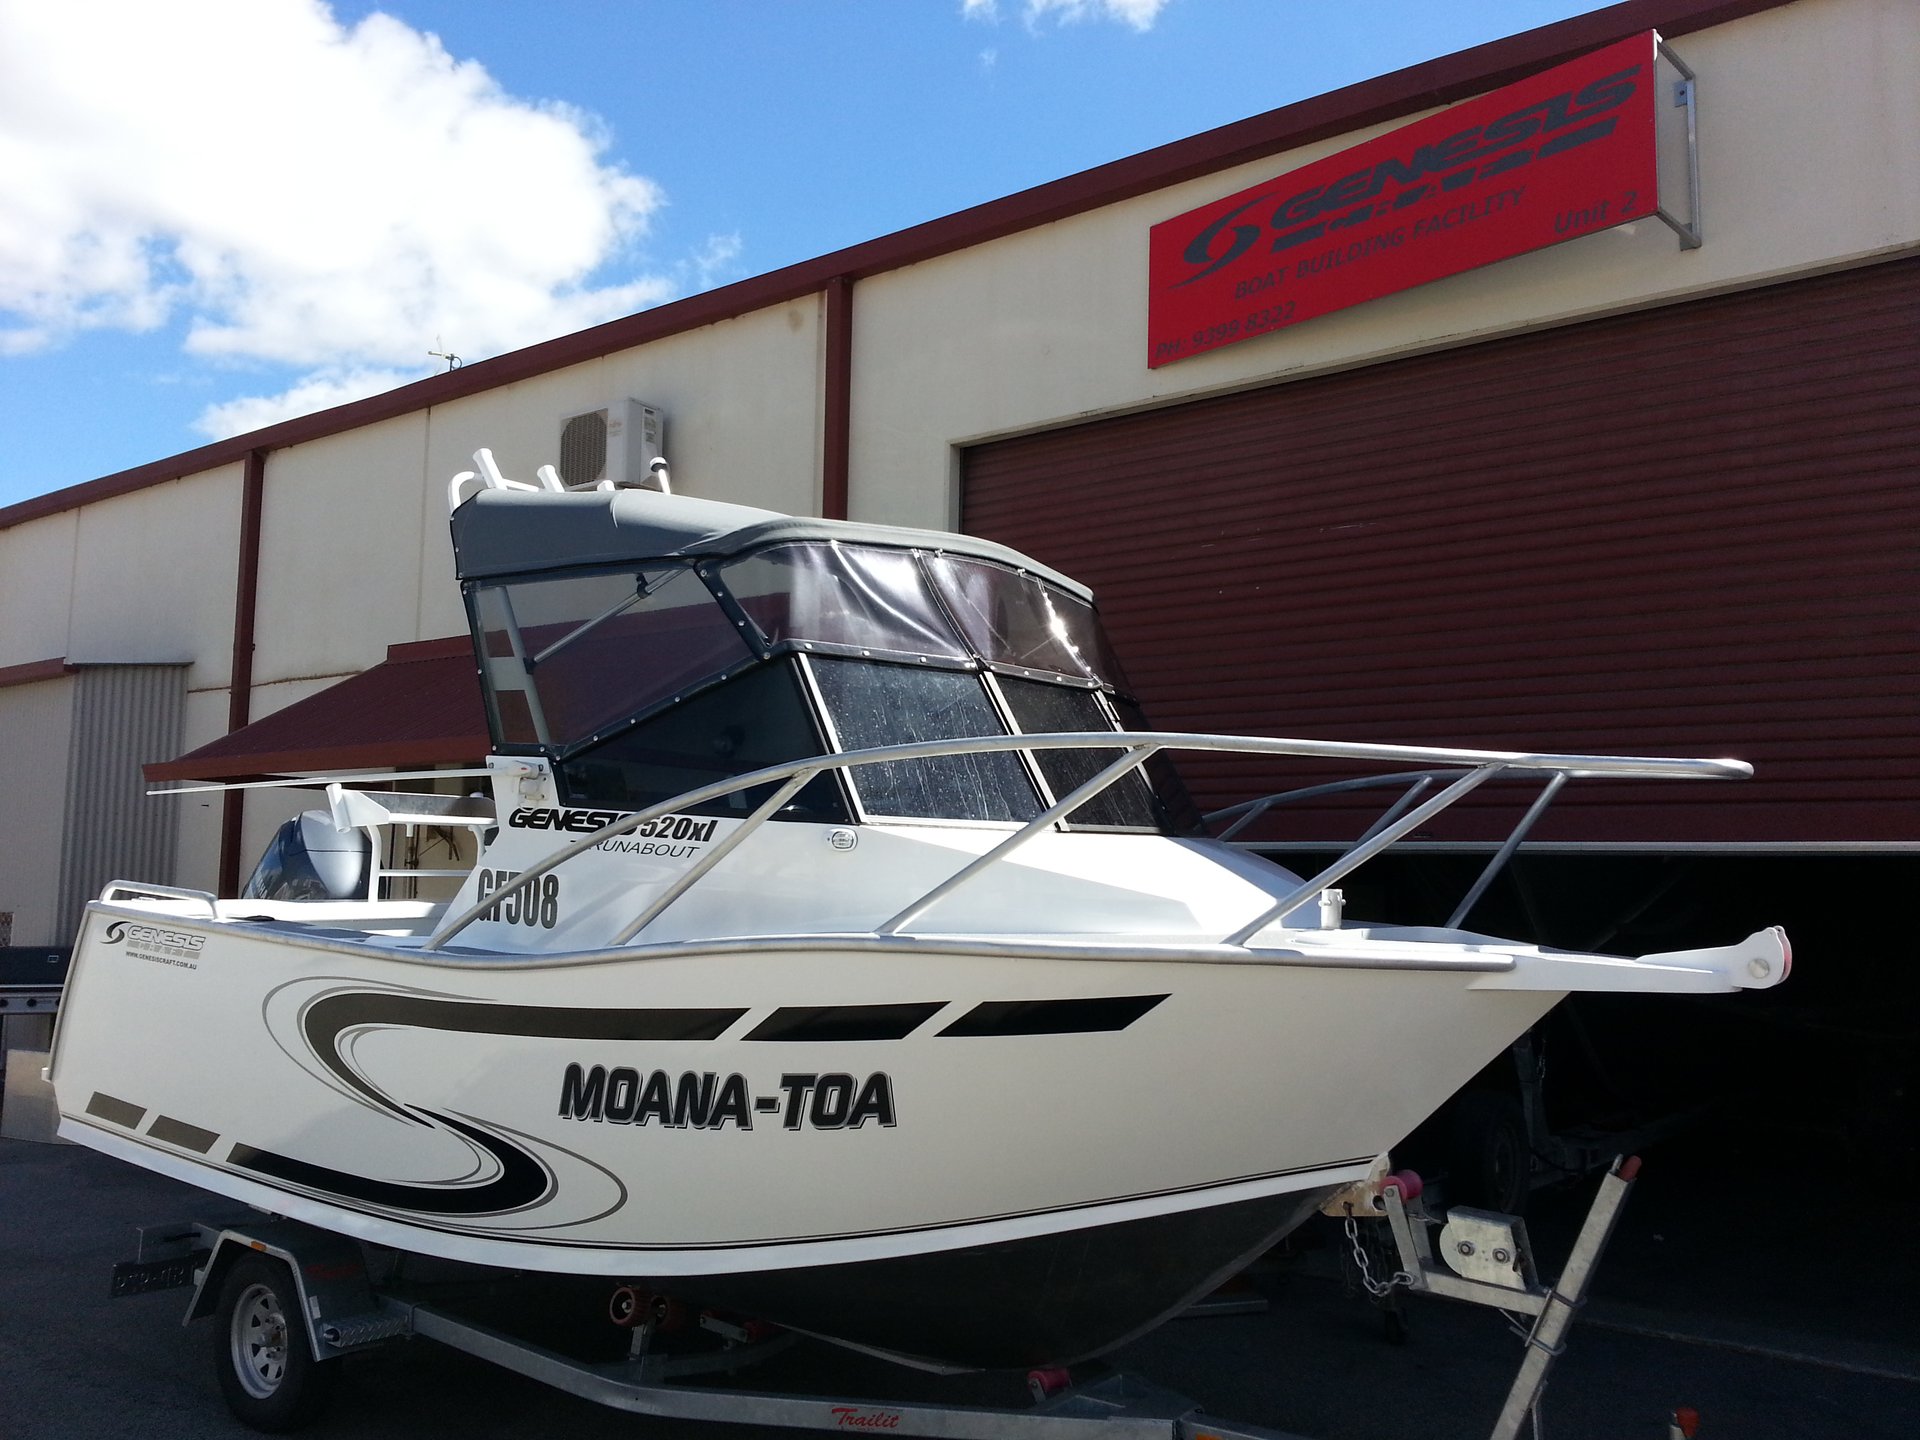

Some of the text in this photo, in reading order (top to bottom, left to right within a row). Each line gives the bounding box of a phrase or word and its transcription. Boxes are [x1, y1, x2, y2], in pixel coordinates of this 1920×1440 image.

[1271, 63, 1642, 230] GENESIS
[1553, 191, 1638, 234] Unit 2
[1234, 184, 1527, 301] BOAT BUILDING FACILITY
[1155, 301, 1297, 359] PH: 9399 8322
[125, 951, 198, 970] WWW.GENESISCRAFT.COM.AU
[127, 925, 206, 951] GENESIS
[558, 1061, 896, 1132] MOANA-TOA
[831, 1407, 900, 1428] Trailit
